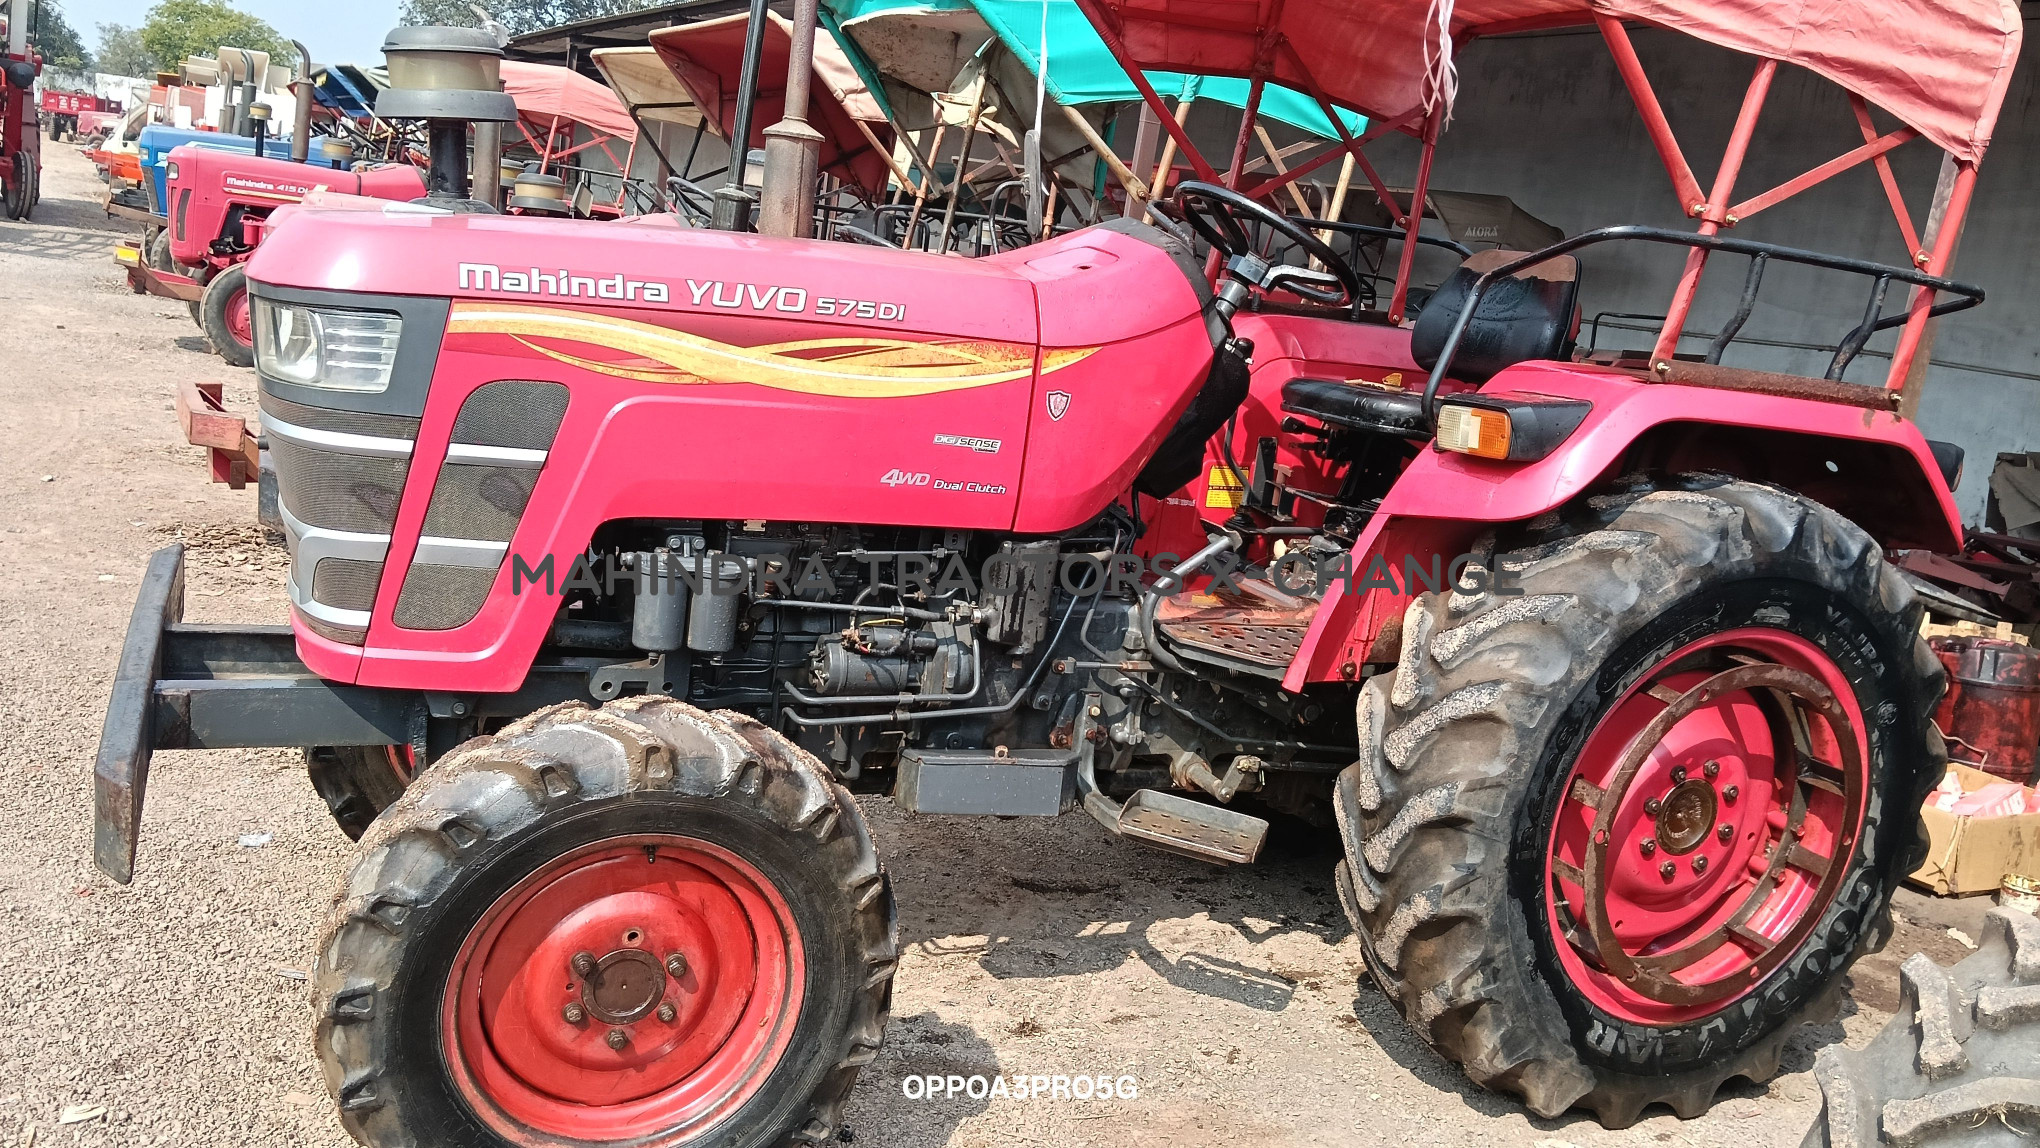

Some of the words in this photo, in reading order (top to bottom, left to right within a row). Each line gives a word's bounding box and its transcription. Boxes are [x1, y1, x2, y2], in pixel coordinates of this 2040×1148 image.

[226, 177, 274, 190] Mahindra
[276, 184, 297, 193] 415
[458, 262, 669, 303] Mahindra
[685, 279, 808, 313] YUVO
[879, 468, 931, 488] 4WD
[933, 479, 964, 491] Dual
[966, 482, 1006, 495] Clutch
